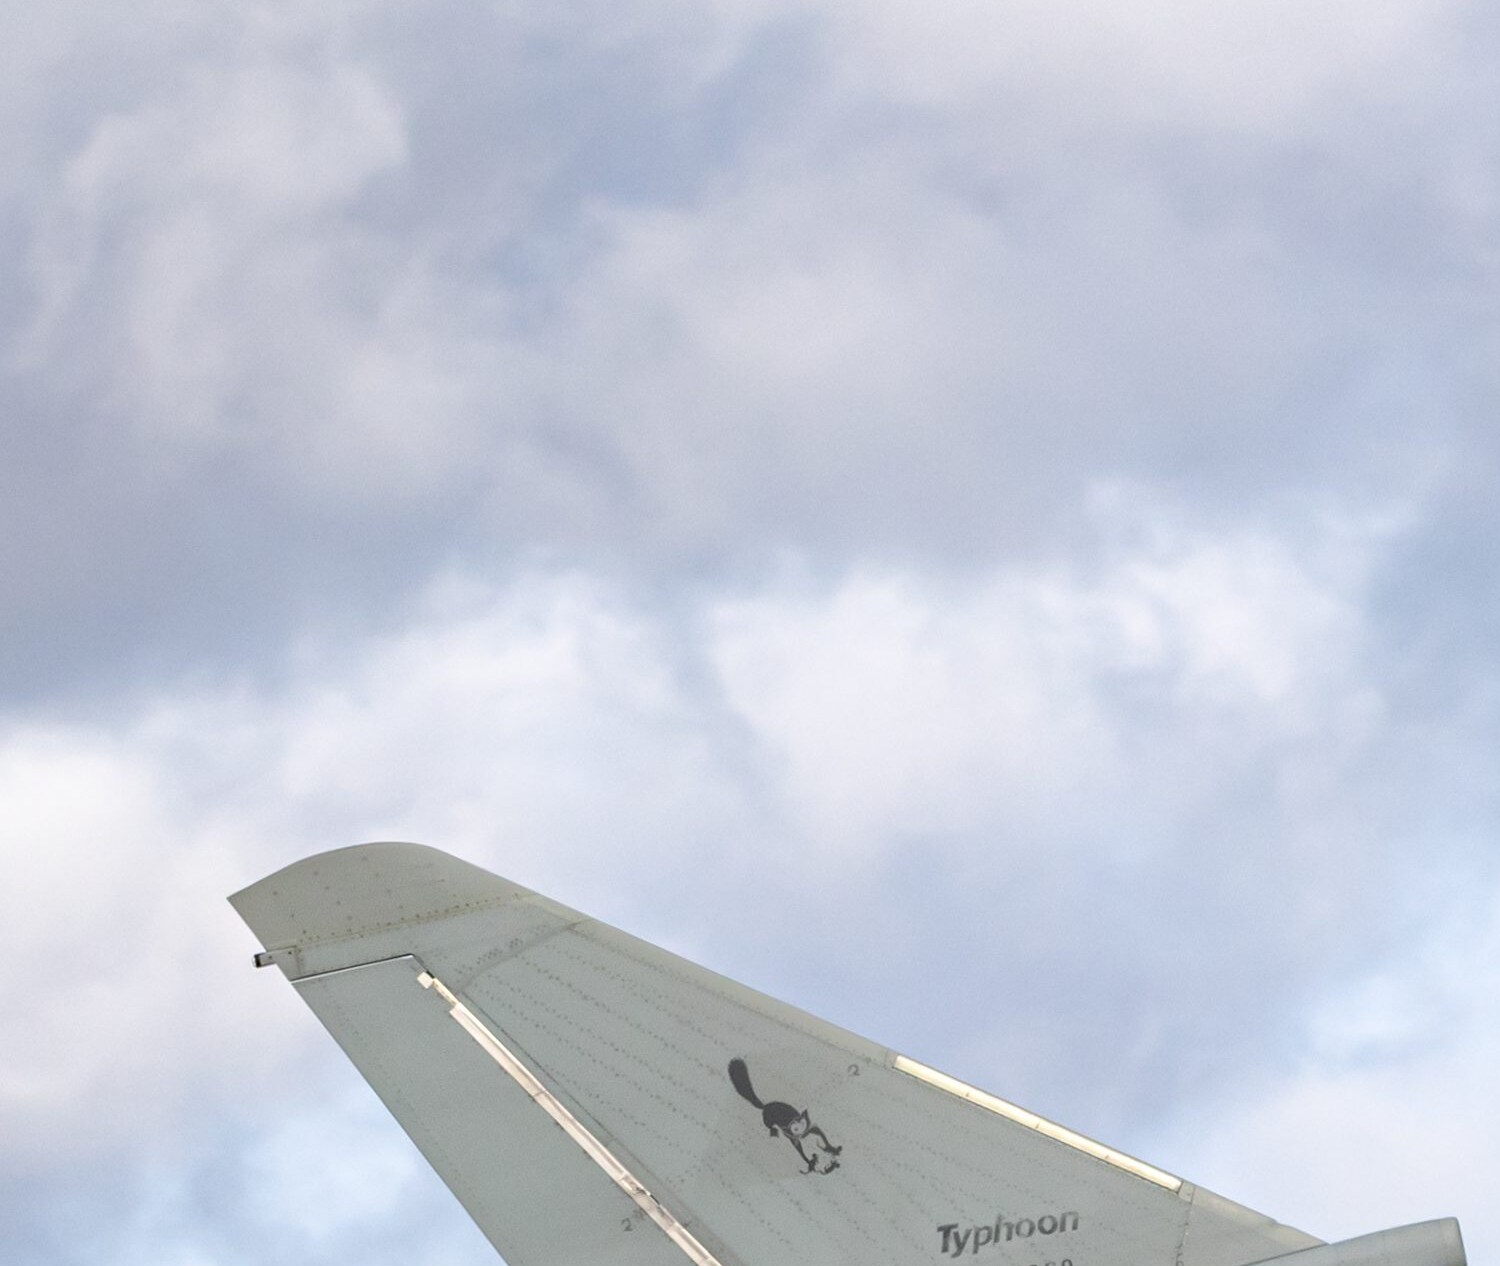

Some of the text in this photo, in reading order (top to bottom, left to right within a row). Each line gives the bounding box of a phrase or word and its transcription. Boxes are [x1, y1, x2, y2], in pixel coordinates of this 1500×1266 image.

[847, 1064, 861, 1077] 2
[621, 1217, 634, 1232] 2
[937, 1211, 1079, 1258] Typhoon
